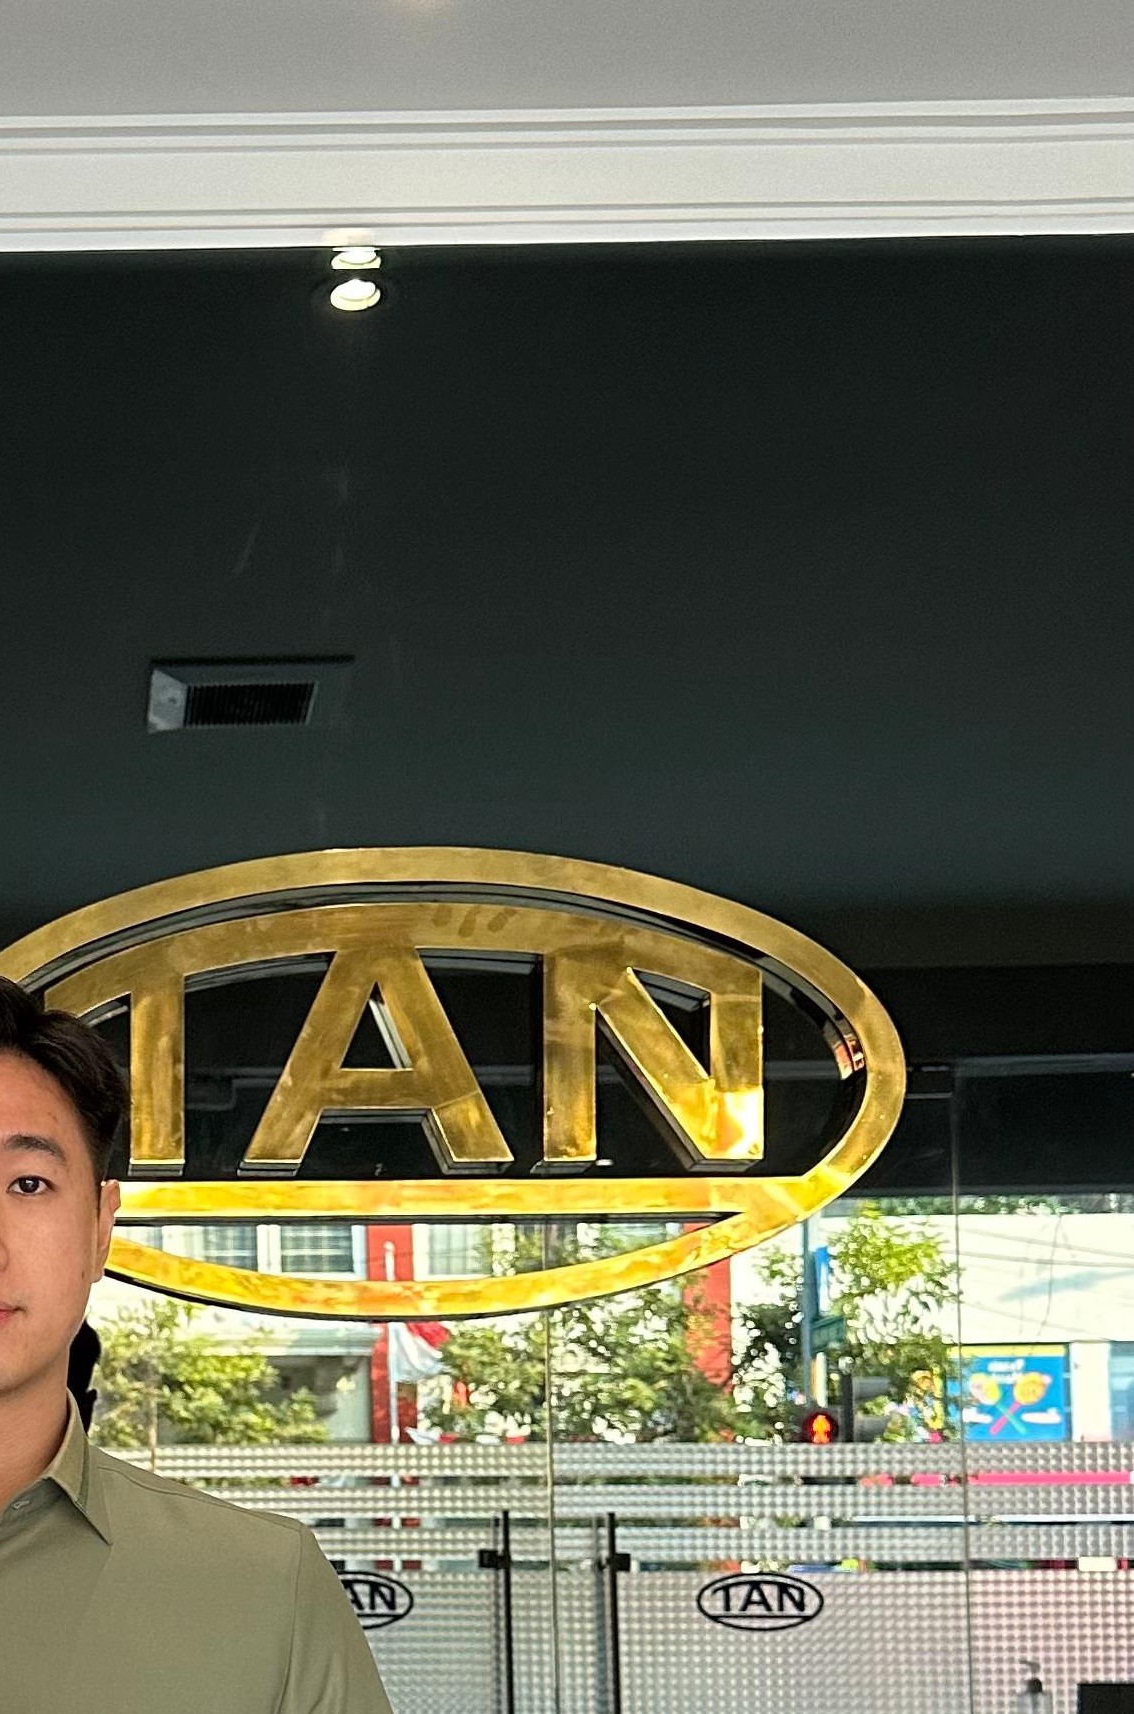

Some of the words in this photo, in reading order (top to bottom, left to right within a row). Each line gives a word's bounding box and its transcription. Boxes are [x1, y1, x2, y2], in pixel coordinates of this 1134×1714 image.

[44, 901, 764, 1170] TAN
[340, 1579, 397, 1612] AN
[710, 1579, 808, 1613] TAN
